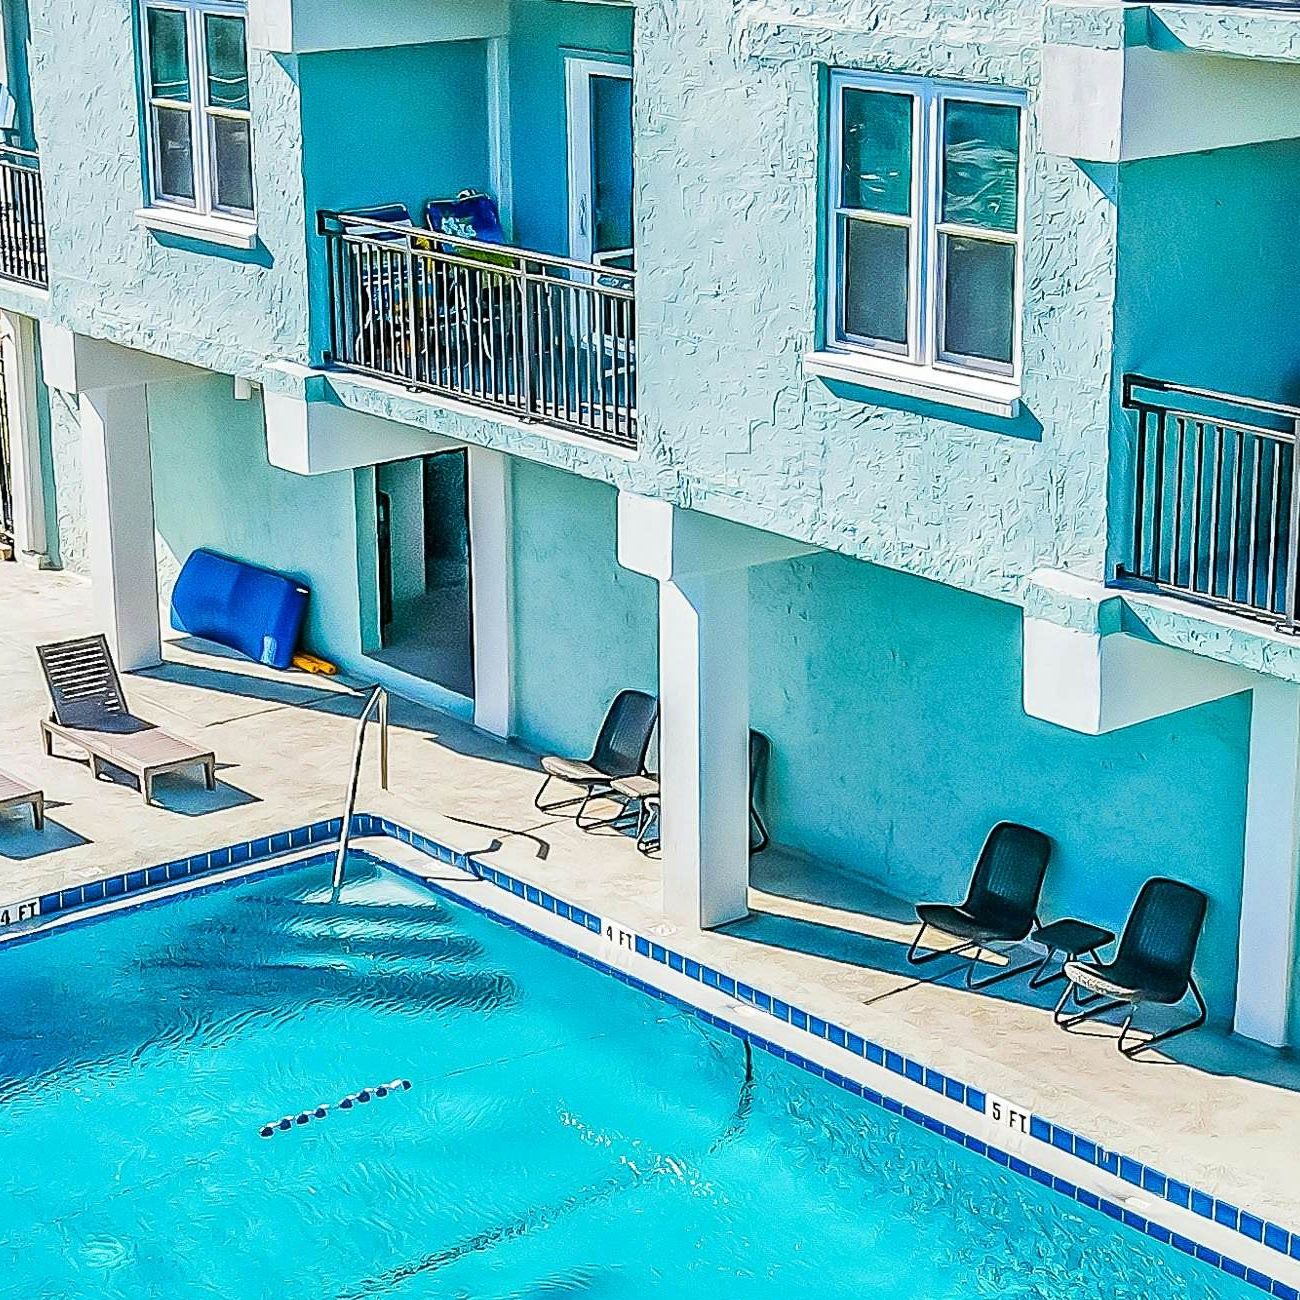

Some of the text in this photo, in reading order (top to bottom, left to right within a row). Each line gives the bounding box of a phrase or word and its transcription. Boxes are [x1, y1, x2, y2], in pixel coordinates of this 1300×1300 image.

[0, 902, 37, 925] 4 FT
[619, 929, 632, 950] FT
[992, 1101, 1027, 1134] 5 FT
